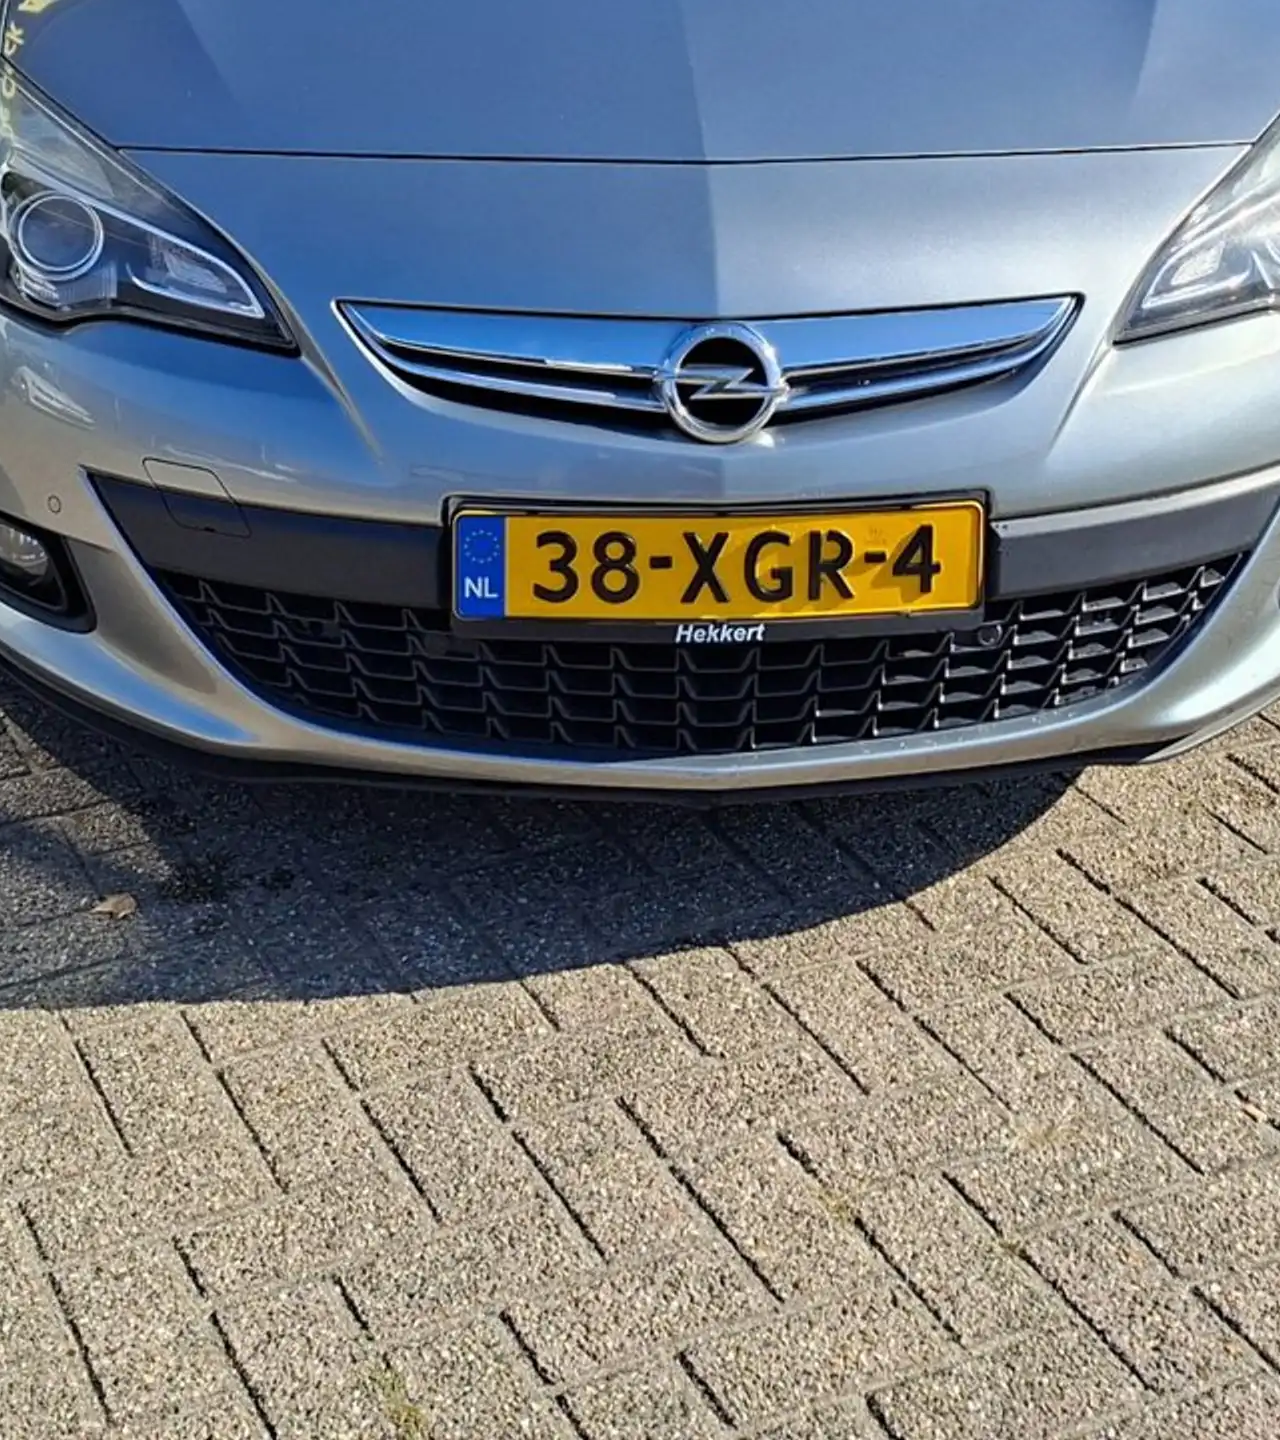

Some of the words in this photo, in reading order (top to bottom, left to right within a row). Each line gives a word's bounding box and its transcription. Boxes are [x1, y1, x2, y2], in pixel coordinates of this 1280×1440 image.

[464, 575, 498, 599] NL
[532, 523, 942, 605] 38-XGR-4
[675, 623, 767, 644] Hekkert
